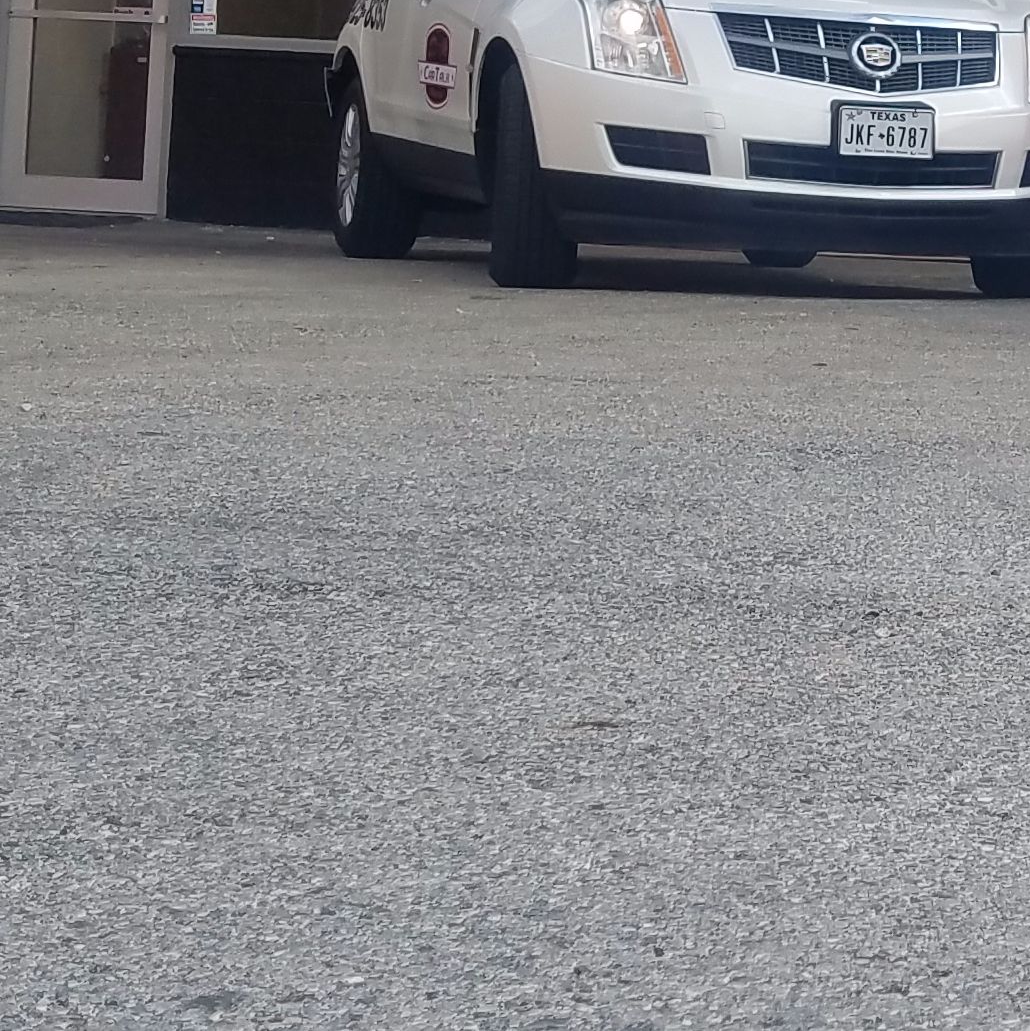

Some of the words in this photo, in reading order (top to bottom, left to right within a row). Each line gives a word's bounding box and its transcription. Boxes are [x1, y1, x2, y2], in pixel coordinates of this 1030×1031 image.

[869, 111, 907, 122] TEXAS
[844, 123, 876, 146] JKF
[886, 125, 928, 149] 6787
